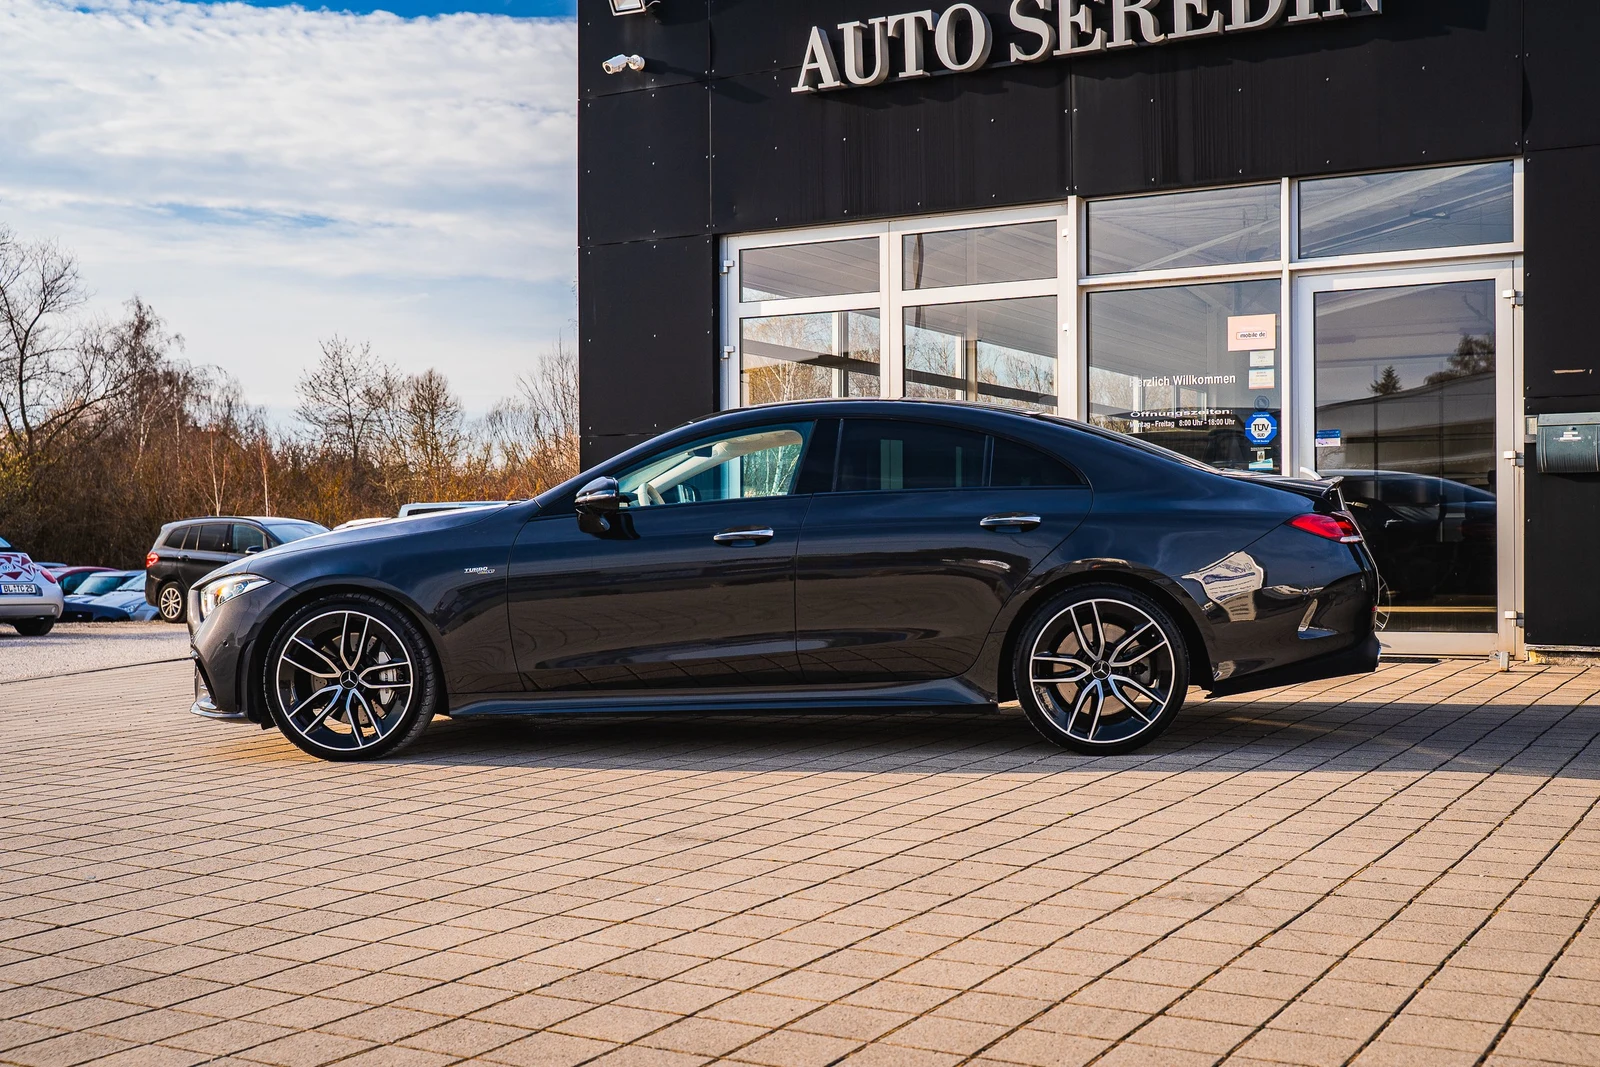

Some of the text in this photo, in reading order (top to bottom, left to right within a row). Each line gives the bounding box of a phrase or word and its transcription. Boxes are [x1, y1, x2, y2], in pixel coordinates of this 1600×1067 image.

[791, 0, 1382, 93] AUTO SERE
[1129, 374, 1236, 388] Herzlich Willkommen
[1130, 409, 1233, 418] Öffnungszeiten:
[1129, 421, 1151, 429] Mntag
[1154, 420, 1175, 429] Freitag
[1178, 419, 1192, 427] 8:00
[1192, 419, 1203, 427] Uhr
[1208, 419, 1224, 427] 18:00
[1224, 418, 1236, 426] Uhr
[1252, 423, 1270, 432] TÜV
